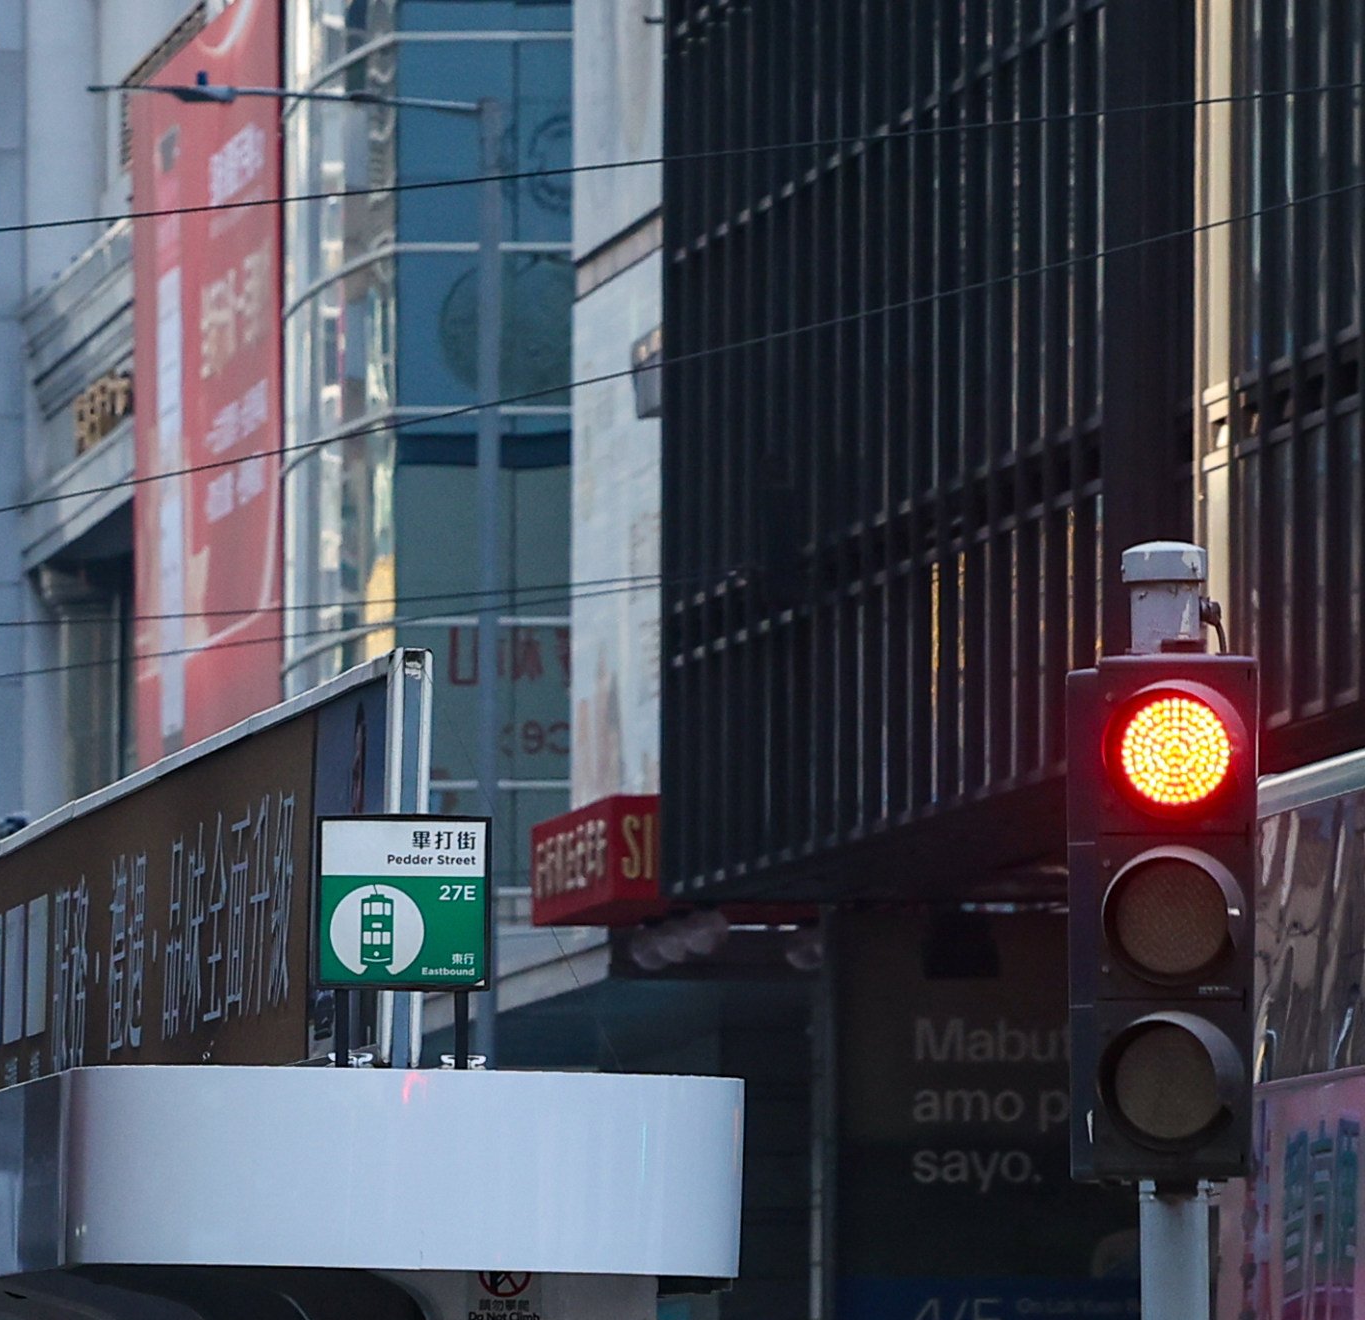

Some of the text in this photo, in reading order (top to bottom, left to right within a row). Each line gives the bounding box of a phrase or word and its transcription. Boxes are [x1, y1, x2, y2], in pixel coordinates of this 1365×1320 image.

[412, 830, 477, 850] 畢打街
[387, 854, 477, 866] Pedder Street
[439, 885, 477, 901] 27E
[452, 953, 475, 965] 東行
[421, 967, 475, 977] Eastbound
[912, 1089, 1025, 1122] amo
[912, 1150, 1043, 1194] sayo.
